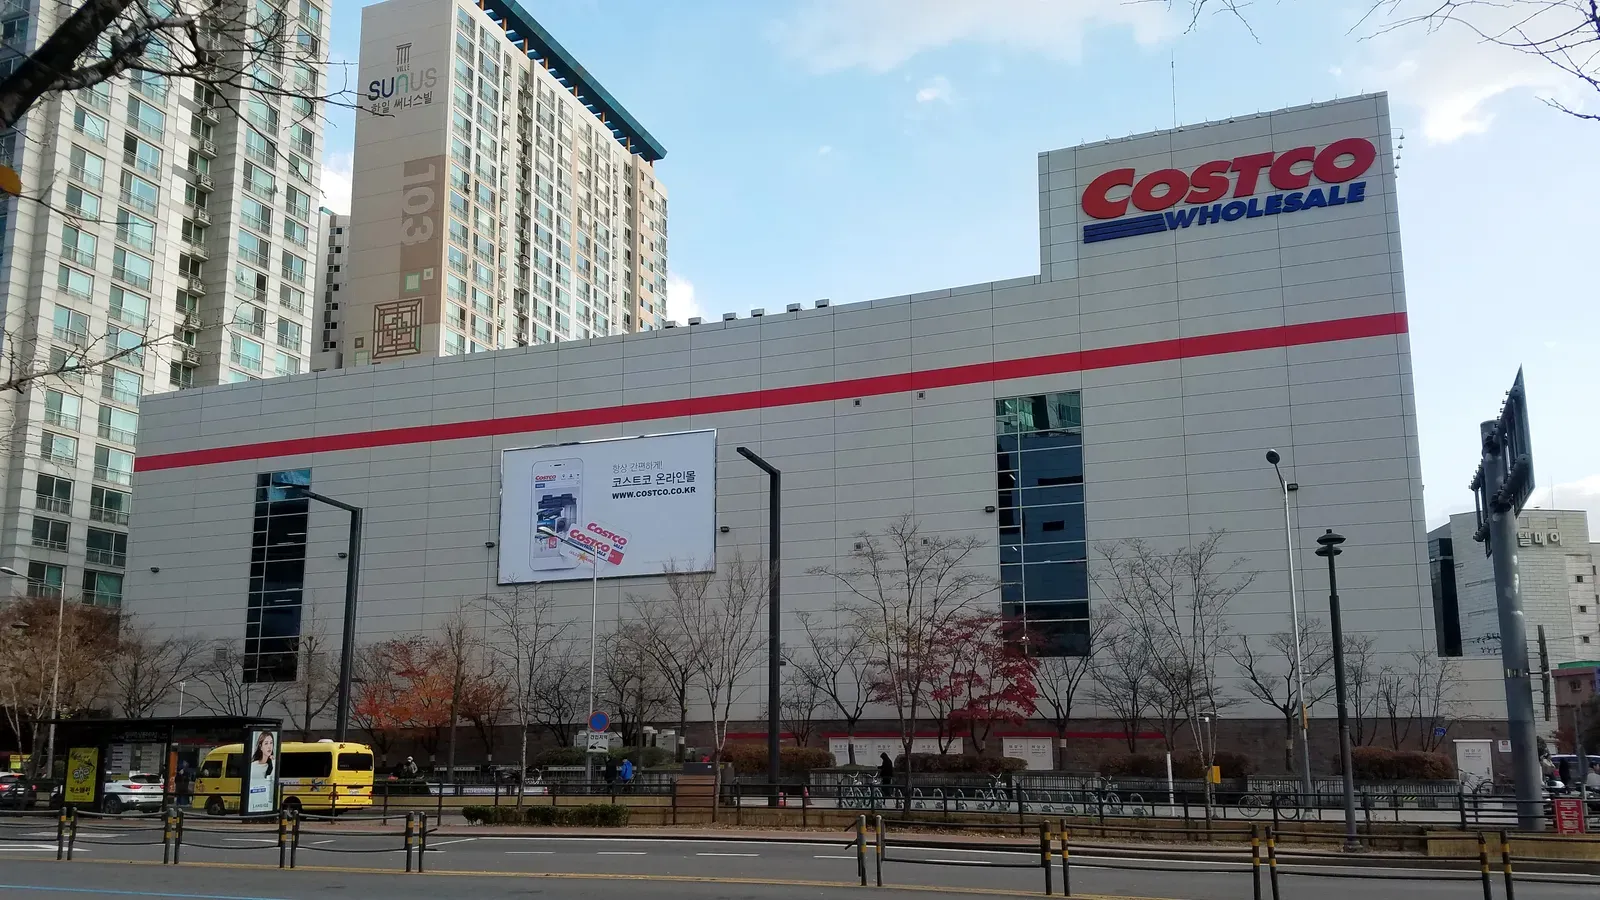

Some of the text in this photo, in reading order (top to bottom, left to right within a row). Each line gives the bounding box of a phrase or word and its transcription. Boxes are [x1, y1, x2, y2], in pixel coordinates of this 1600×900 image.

[396, 64, 410, 72] VILLE
[371, 91, 433, 115] 한일 써너스빌
[1081, 137, 1377, 220] COSTCO
[401, 163, 436, 246] 103
[1163, 181, 1367, 231] WHOLESALE
[612, 460, 663, 474] 항상 간편하게!
[612, 470, 696, 488] 코스트코 온라인몰
[612, 486, 696, 499] WWW.COSTCO.CO.KR
[569, 529, 611, 553] COSTCO
[587, 522, 627, 546] COSTCO
